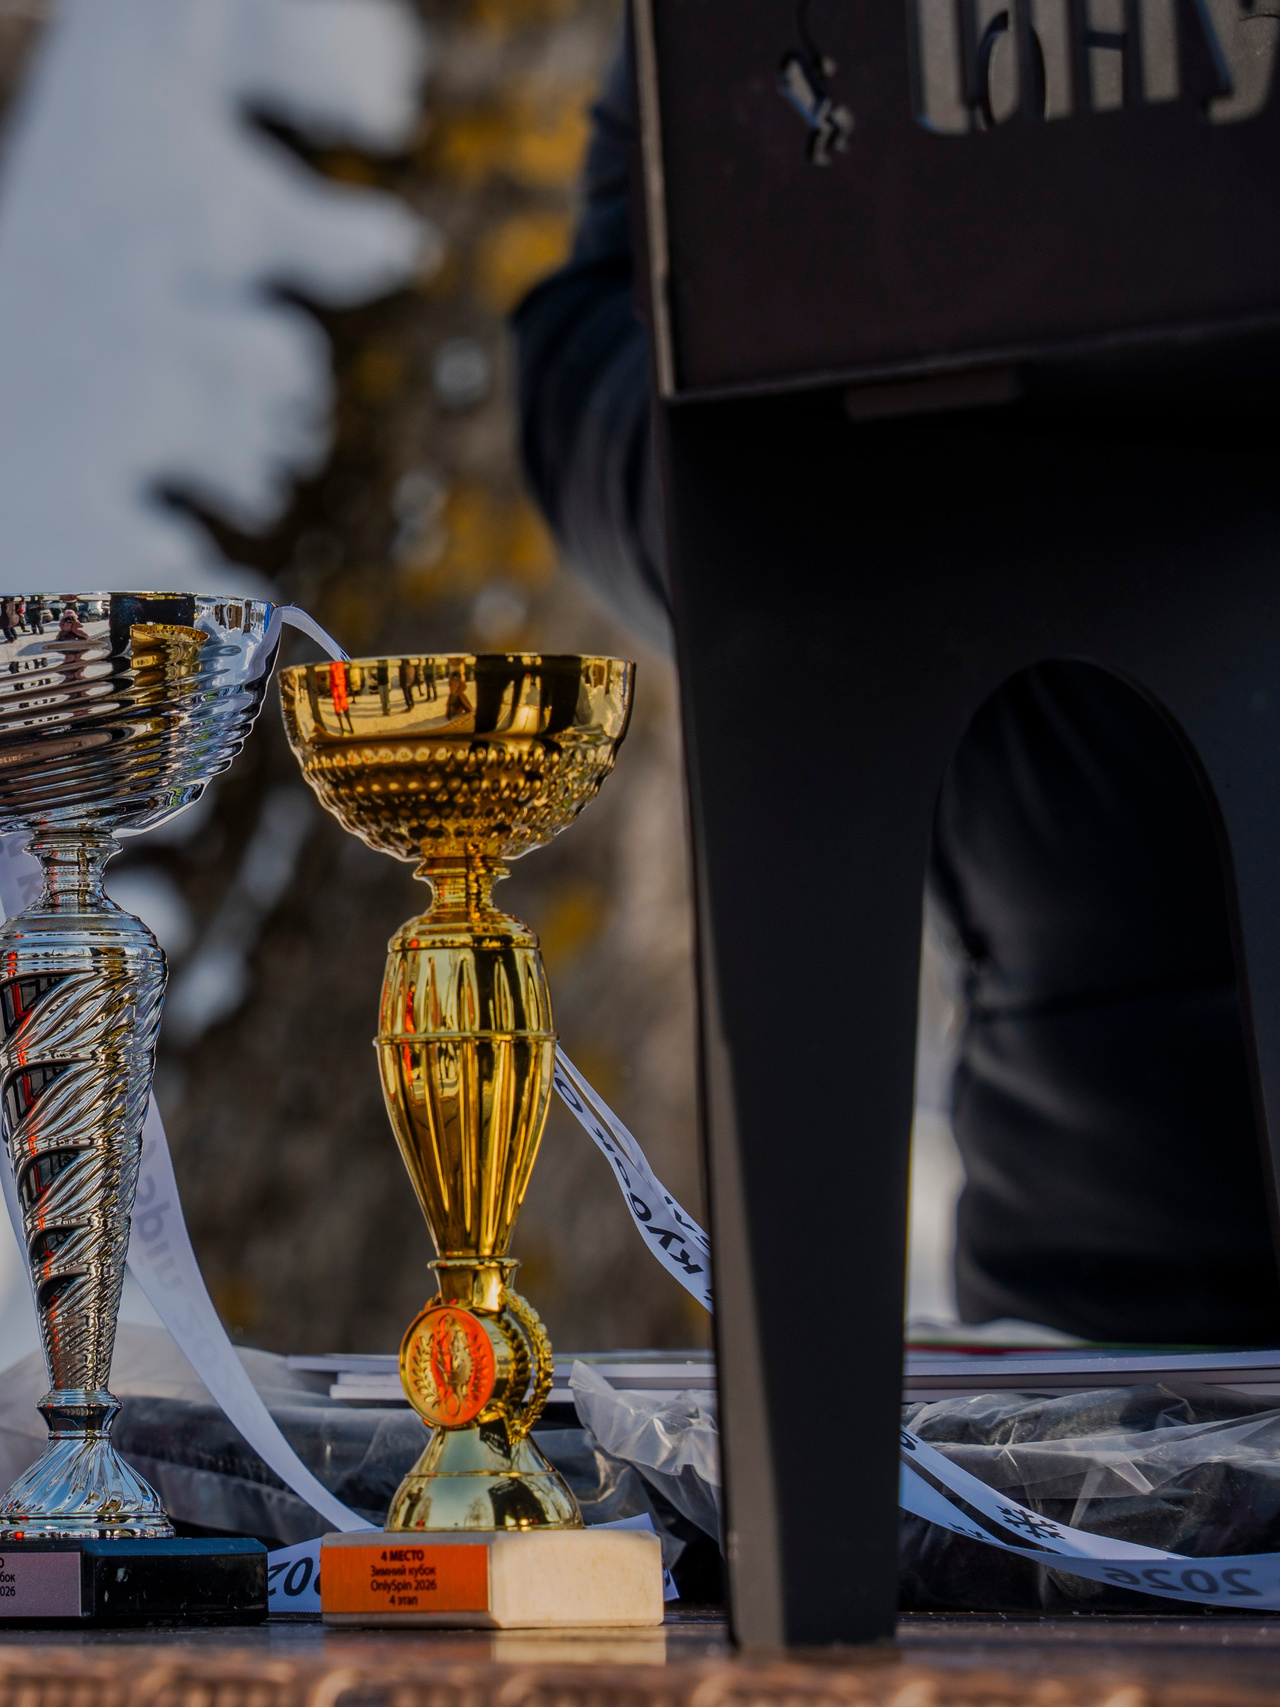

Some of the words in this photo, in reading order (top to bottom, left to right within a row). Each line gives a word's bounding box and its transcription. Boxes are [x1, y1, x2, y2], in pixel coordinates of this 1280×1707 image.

[380, 1551, 389, 1562] 4
[390, 1550, 425, 1562] МЕСТО
[370, 1564, 406, 1577] Зимний
[408, 1564, 436, 1578] кубок
[370, 1579, 412, 1594] OnlySpin
[414, 1579, 437, 1592] 2026
[389, 1594, 398, 1606] 4
[399, 1597, 418, 1606] этап
